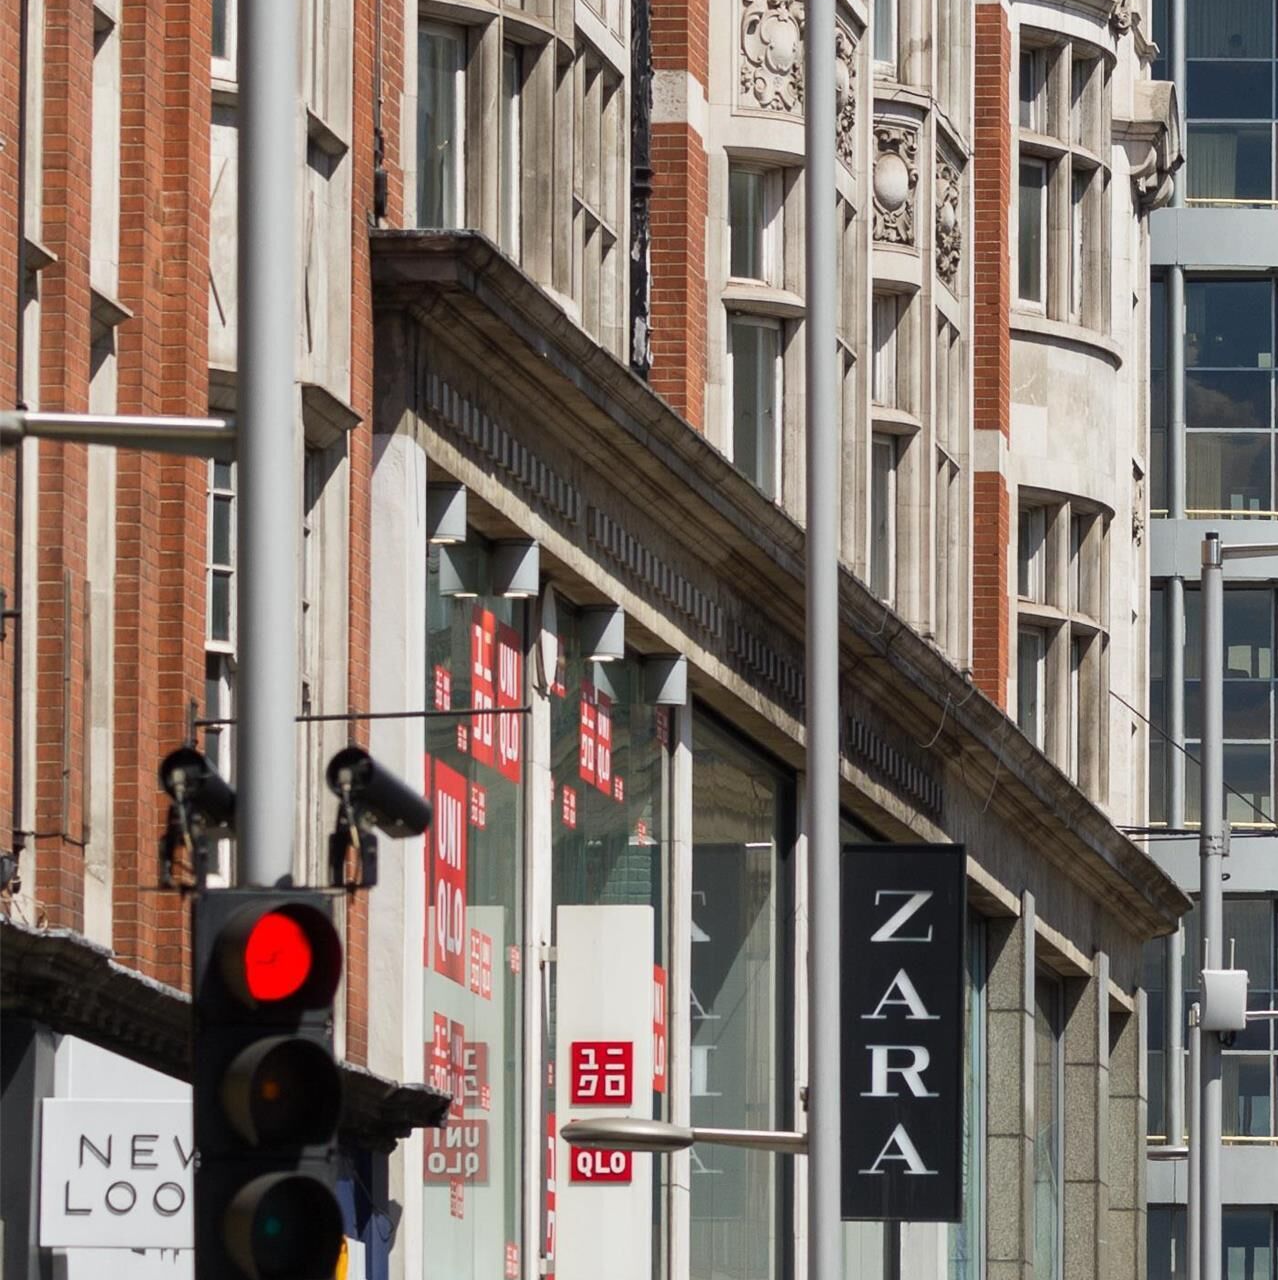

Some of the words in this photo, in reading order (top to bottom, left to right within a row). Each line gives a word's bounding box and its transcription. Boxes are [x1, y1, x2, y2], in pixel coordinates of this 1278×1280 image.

[500, 642, 518, 700] UNI
[438, 789, 462, 870] UNI
[438, 878, 463, 962] QLO
[858, 890, 940, 1175] ZARA
[65, 1180, 186, 1217] LOO
[577, 1151, 626, 1177] QLO
